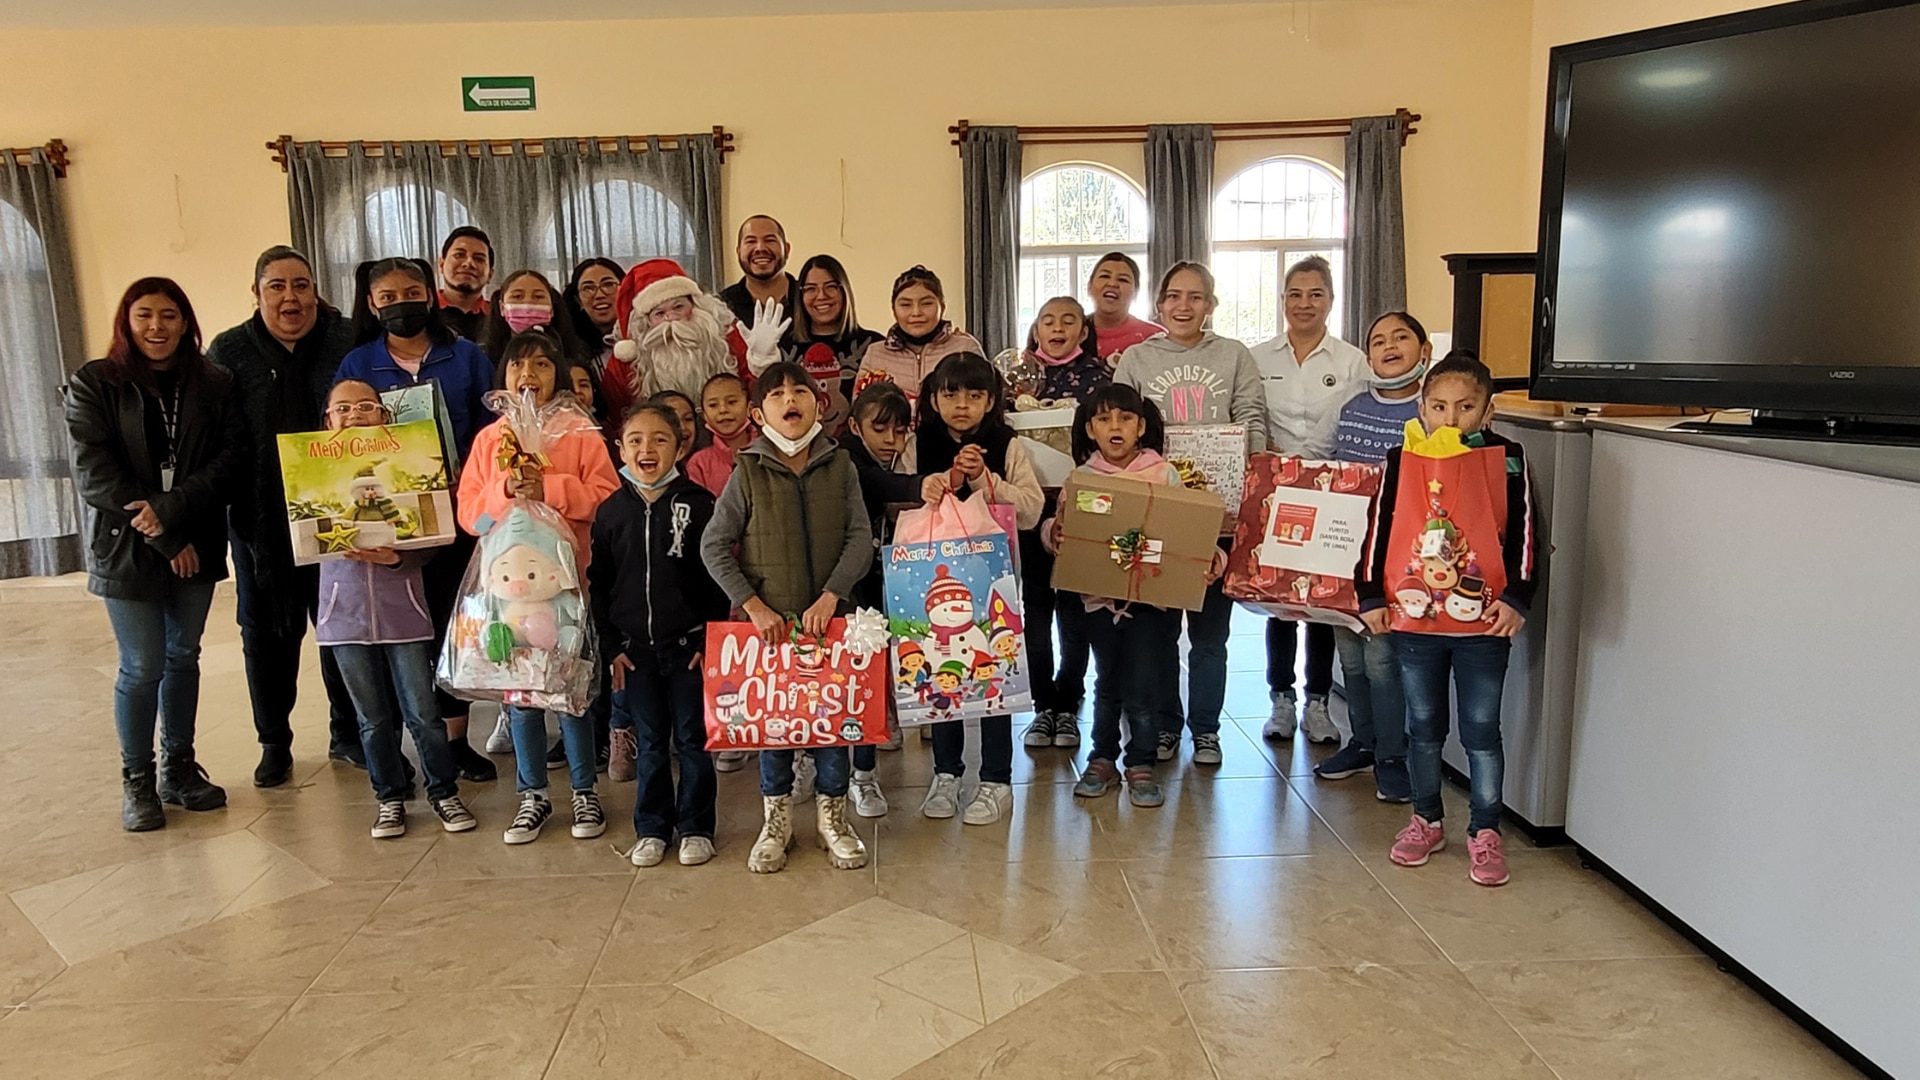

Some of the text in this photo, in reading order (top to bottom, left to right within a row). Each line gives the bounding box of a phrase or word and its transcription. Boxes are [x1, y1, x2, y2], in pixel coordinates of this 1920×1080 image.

[1829, 371, 1855, 379] VIZIO
[1171, 384, 1206, 423] NY
[1210, 406, 1218, 419] 7
[309, 440, 344, 460] Merry
[892, 540, 995, 563] Merry Christmas
[738, 673, 866, 722] Christ
